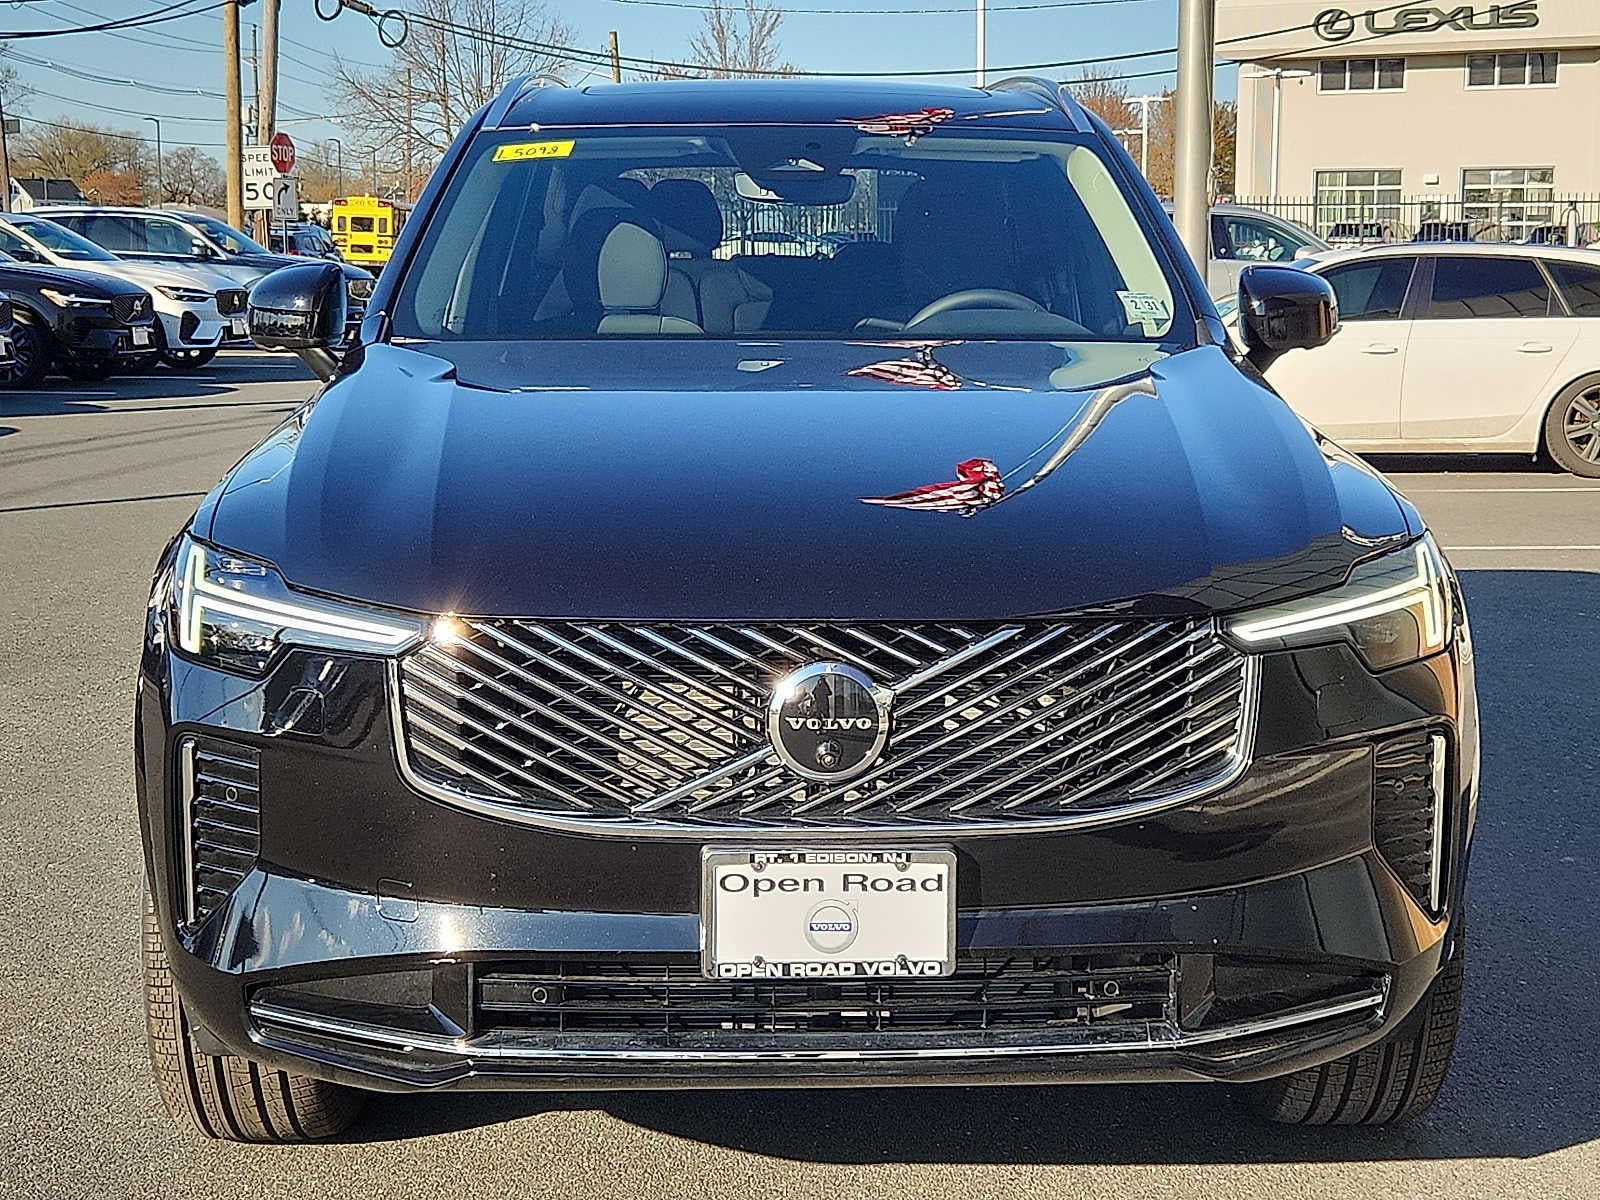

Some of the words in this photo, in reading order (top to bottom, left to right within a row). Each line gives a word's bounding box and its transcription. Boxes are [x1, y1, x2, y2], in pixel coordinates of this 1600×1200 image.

[1365, 4, 1539, 34] LEXUS
[241, 153, 269, 162] SPEE
[271, 145, 294, 162] STOP
[245, 167, 274, 176] LIMIT
[1130, 300, 1141, 310] 2
[1144, 300, 1160, 311] 31
[784, 716, 873, 731] VOLVO
[789, 853, 799, 863] 1
[883, 852, 907, 863] NJ
[719, 873, 825, 897] Open
[842, 873, 943, 892] Road
[811, 922, 850, 931] VOLVO
[718, 963, 783, 977] OPEN
[790, 962, 856, 976] ROAD
[862, 961, 941, 976] VOLVO
